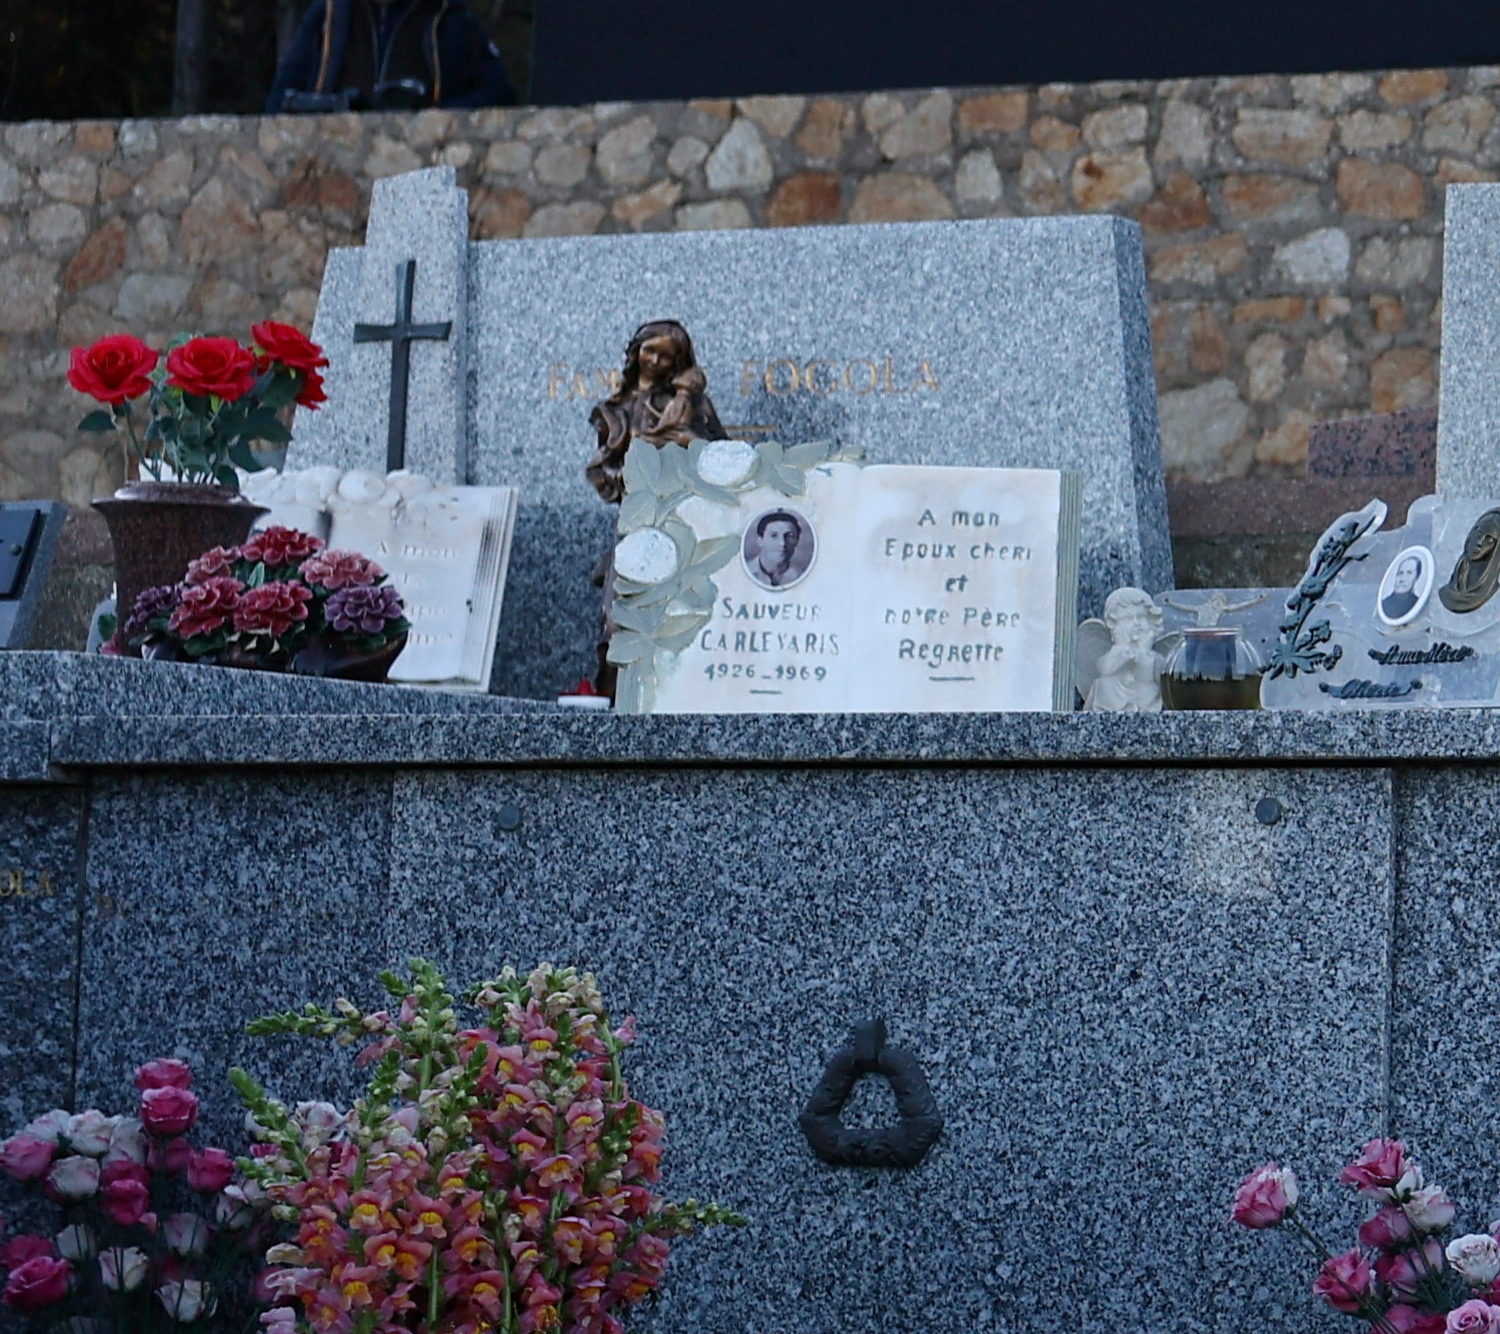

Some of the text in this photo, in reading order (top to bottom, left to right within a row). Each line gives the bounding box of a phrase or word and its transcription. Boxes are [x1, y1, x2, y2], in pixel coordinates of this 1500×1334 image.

[740, 356, 942, 397] FOGOLA
[917, 509, 1000, 527] A mon
[945, 575, 968, 593] et
[722, 597, 822, 620] SAUVEUR
[701, 629, 840, 656] CARLEVARIS
